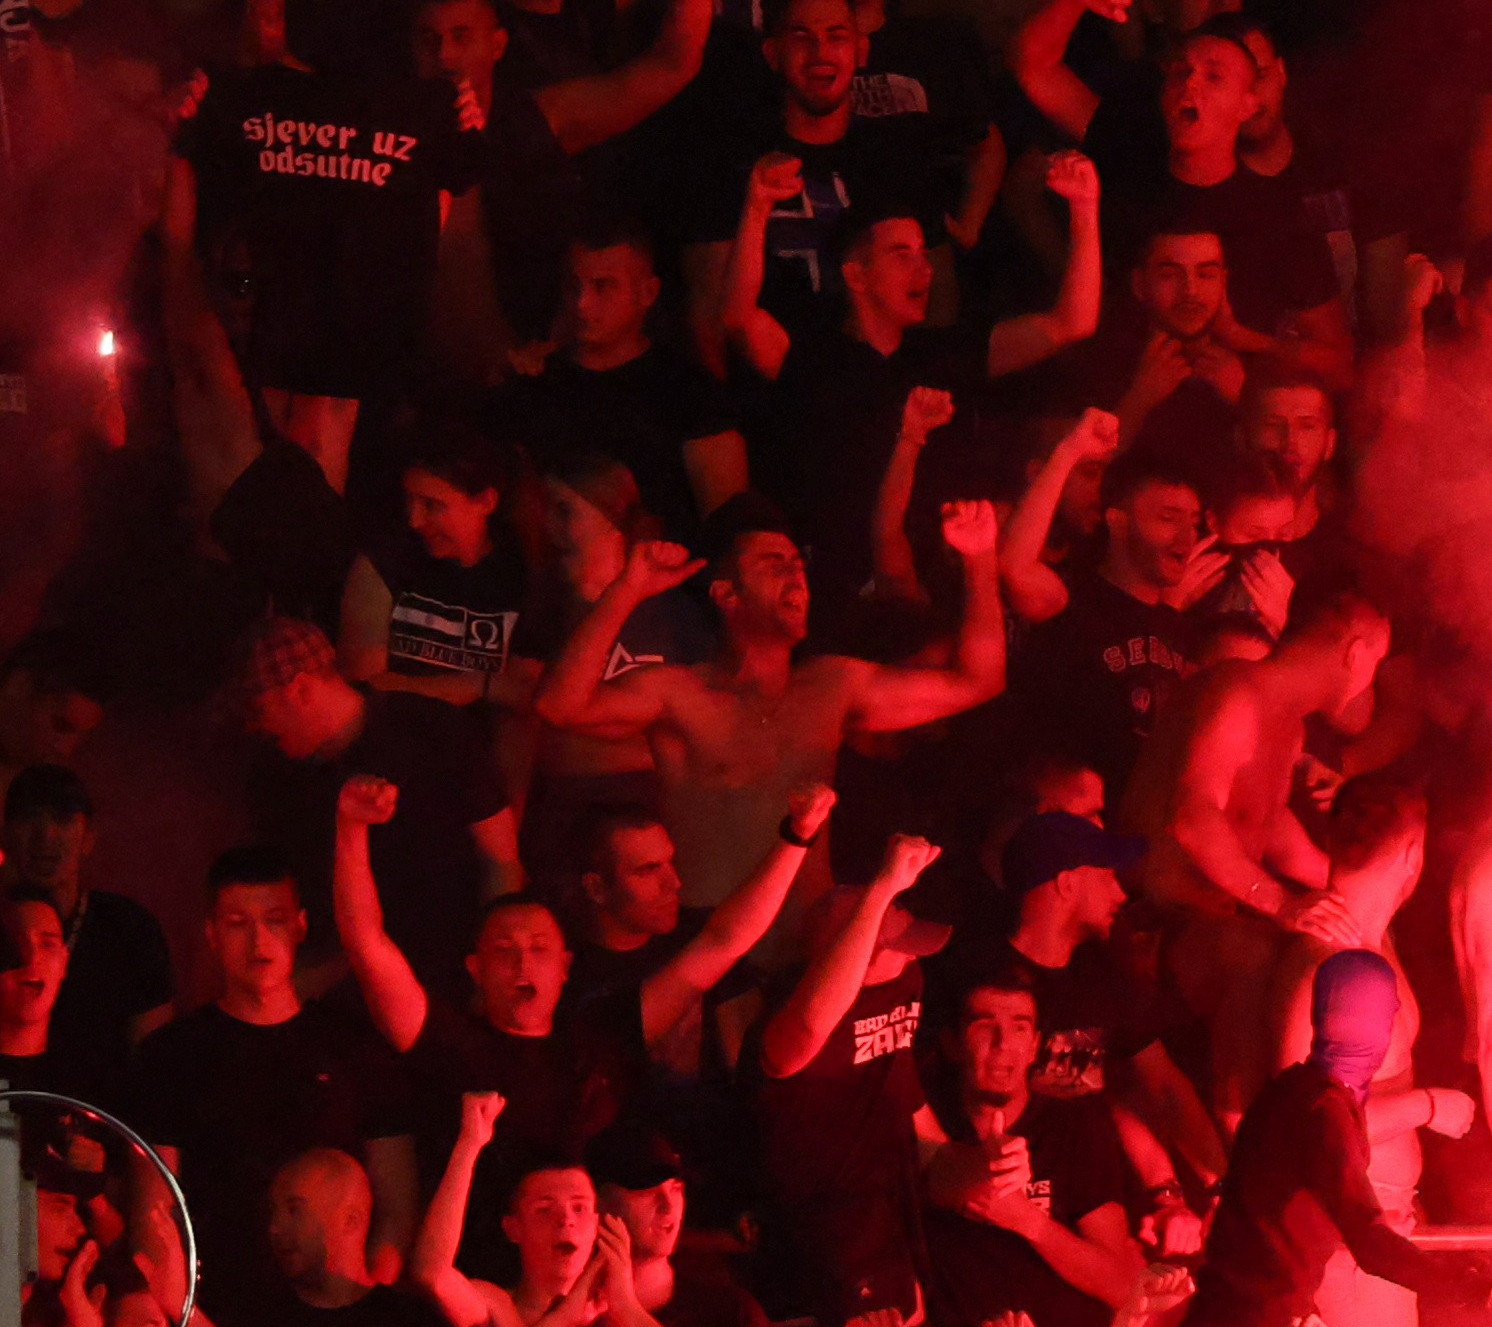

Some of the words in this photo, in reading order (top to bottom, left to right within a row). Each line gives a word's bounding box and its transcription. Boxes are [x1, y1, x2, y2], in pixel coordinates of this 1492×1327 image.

[243, 112, 357, 152] sjever
[373, 131, 418, 162] uz
[258, 142, 393, 187] odsutne
[851, 1013, 890, 1036] BAD
